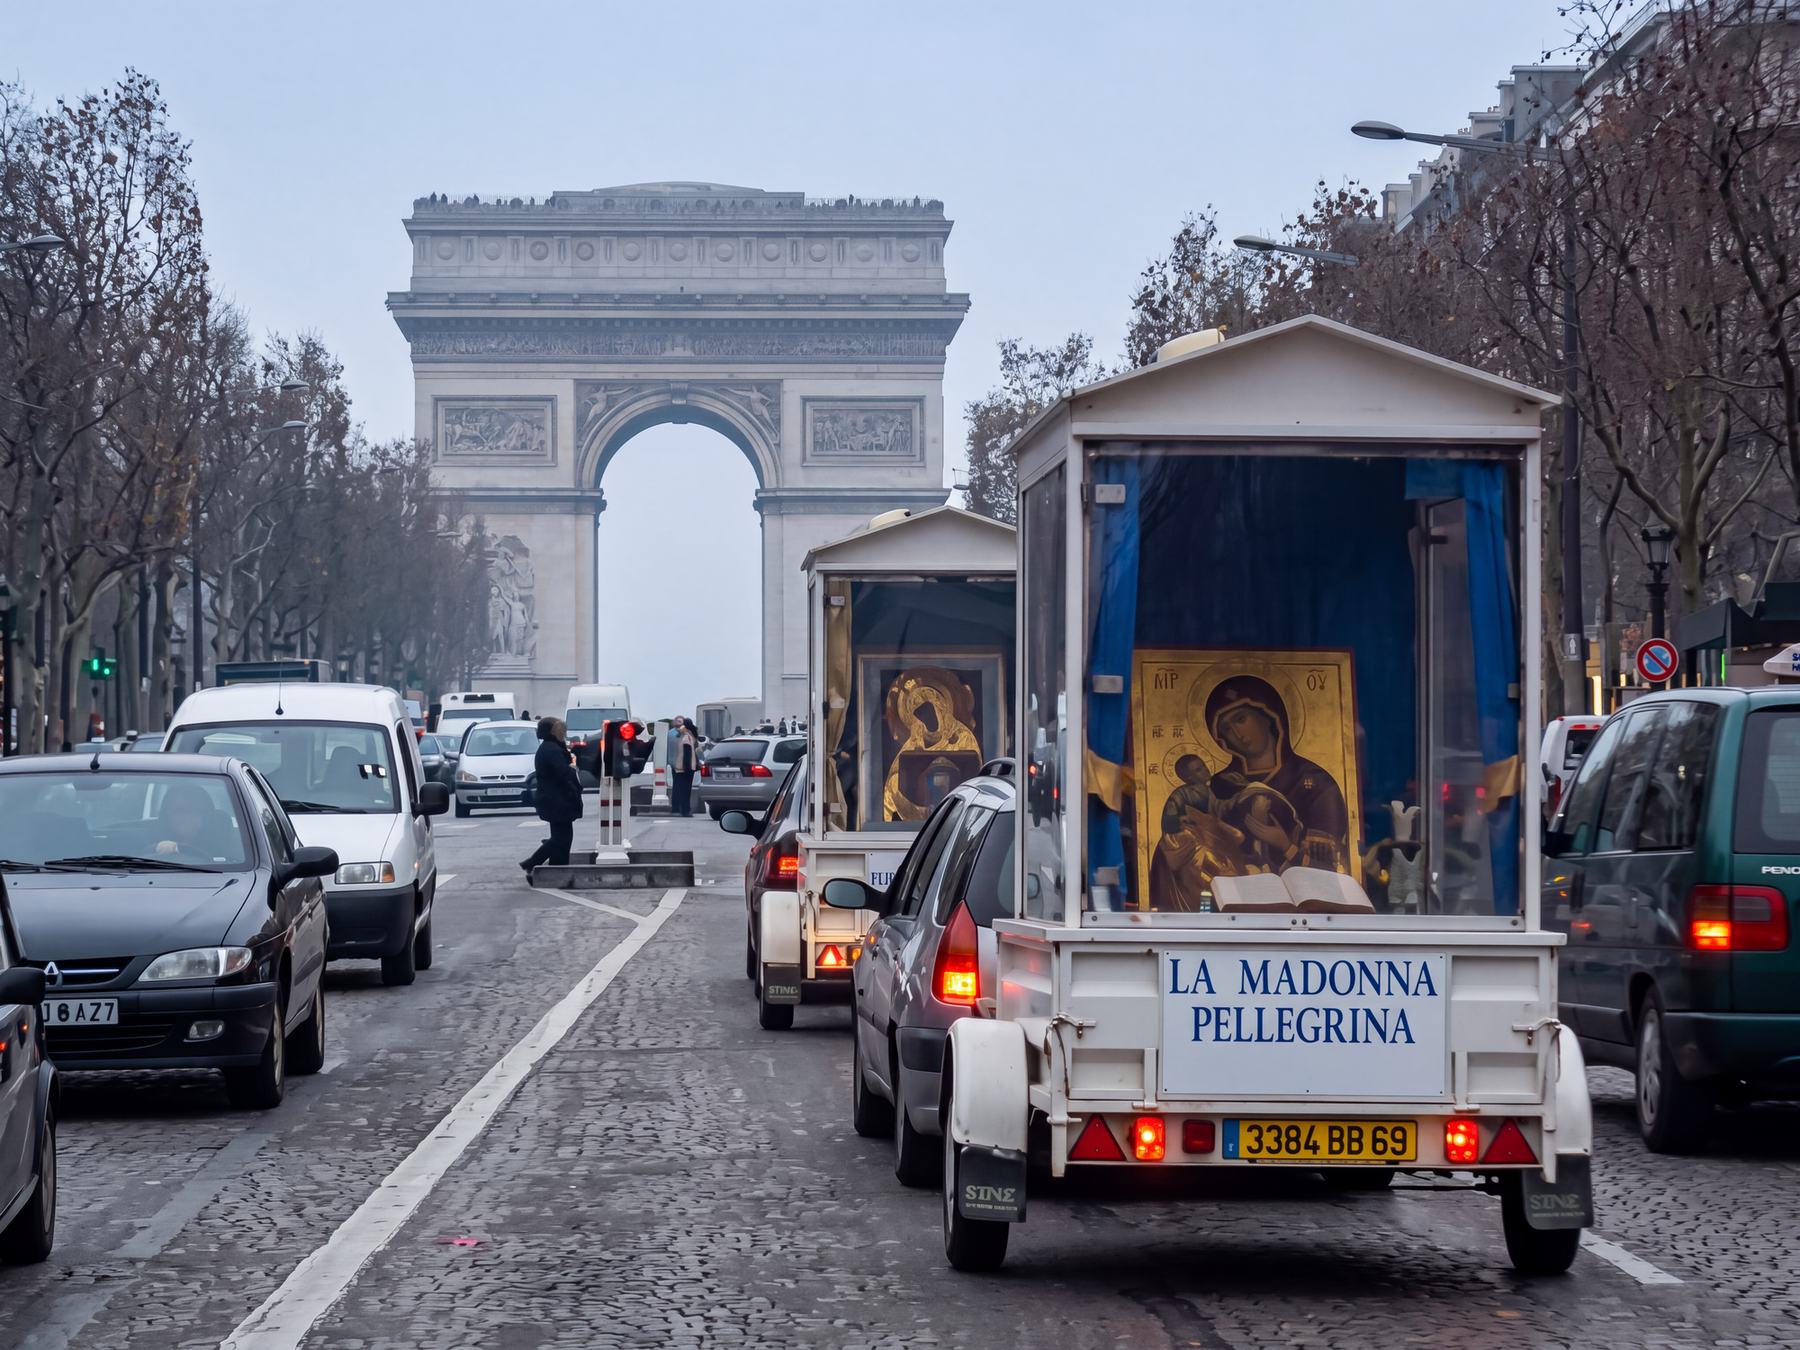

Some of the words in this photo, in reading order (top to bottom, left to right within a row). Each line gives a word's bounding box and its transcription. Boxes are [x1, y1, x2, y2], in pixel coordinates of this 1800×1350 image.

[1169, 958, 1216, 995] LA
[1238, 959, 1438, 997] MADONNA
[1192, 1006, 1415, 1044] PELLEGRINA
[1245, 1124, 1320, 1155] 3384
[1328, 1125, 1364, 1155] BB
[1371, 1126, 1408, 1156] 69
